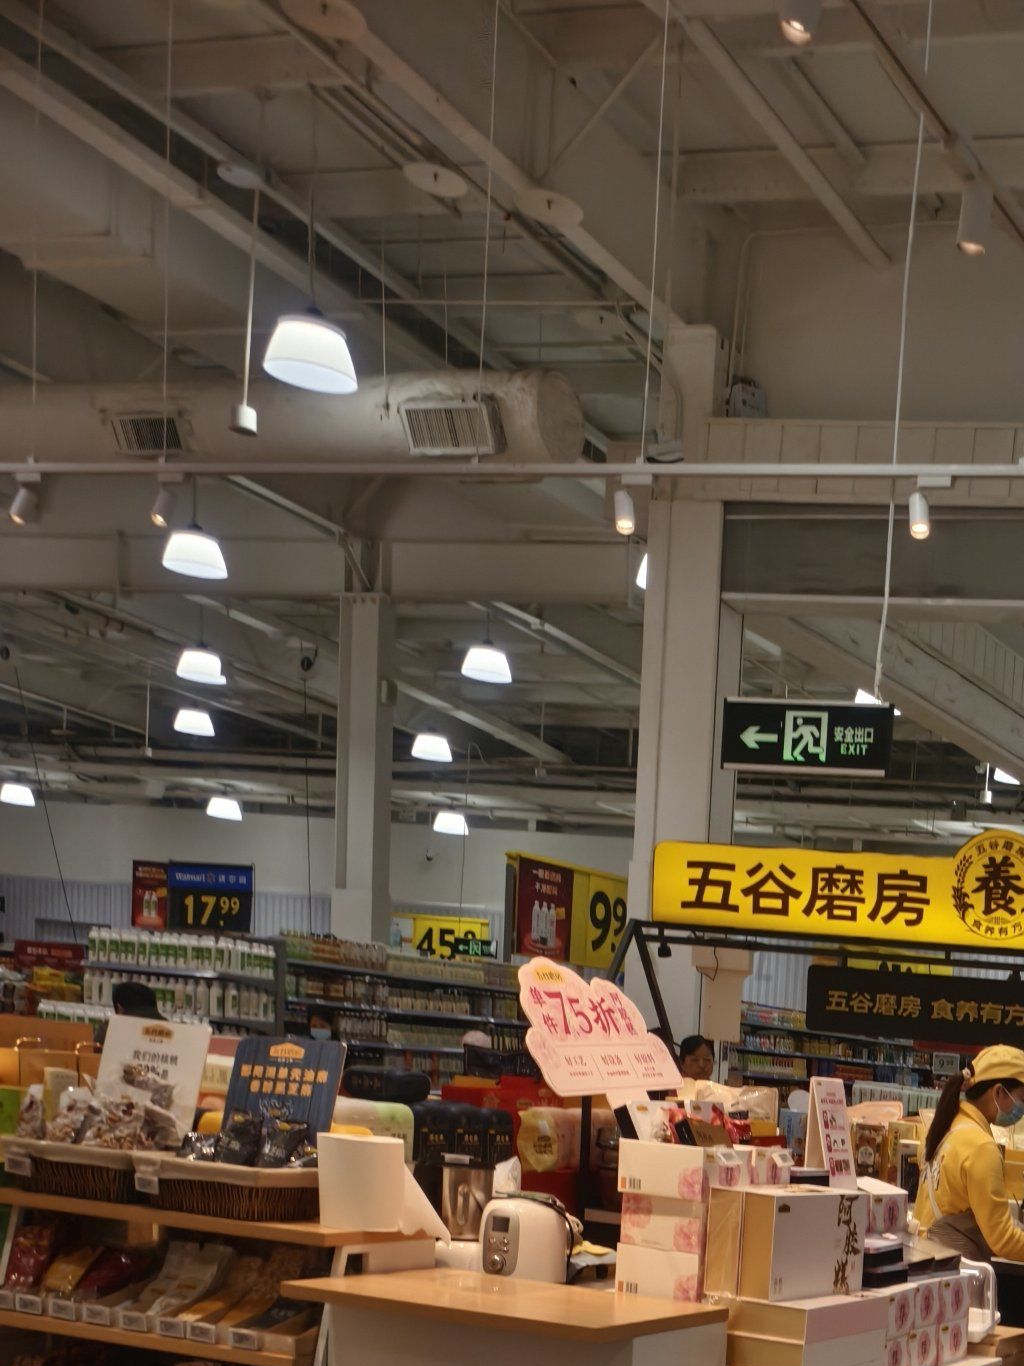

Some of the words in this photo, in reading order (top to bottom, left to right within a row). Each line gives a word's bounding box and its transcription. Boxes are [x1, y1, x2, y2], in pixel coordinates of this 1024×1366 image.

[834, 726, 874, 744] 安全出口
[840, 744, 868, 756] EXIT
[680, 859, 931, 928] 五谷磨房
[183, 894, 240, 927] 17.99
[825, 990, 922, 1019] 五谷磨房
